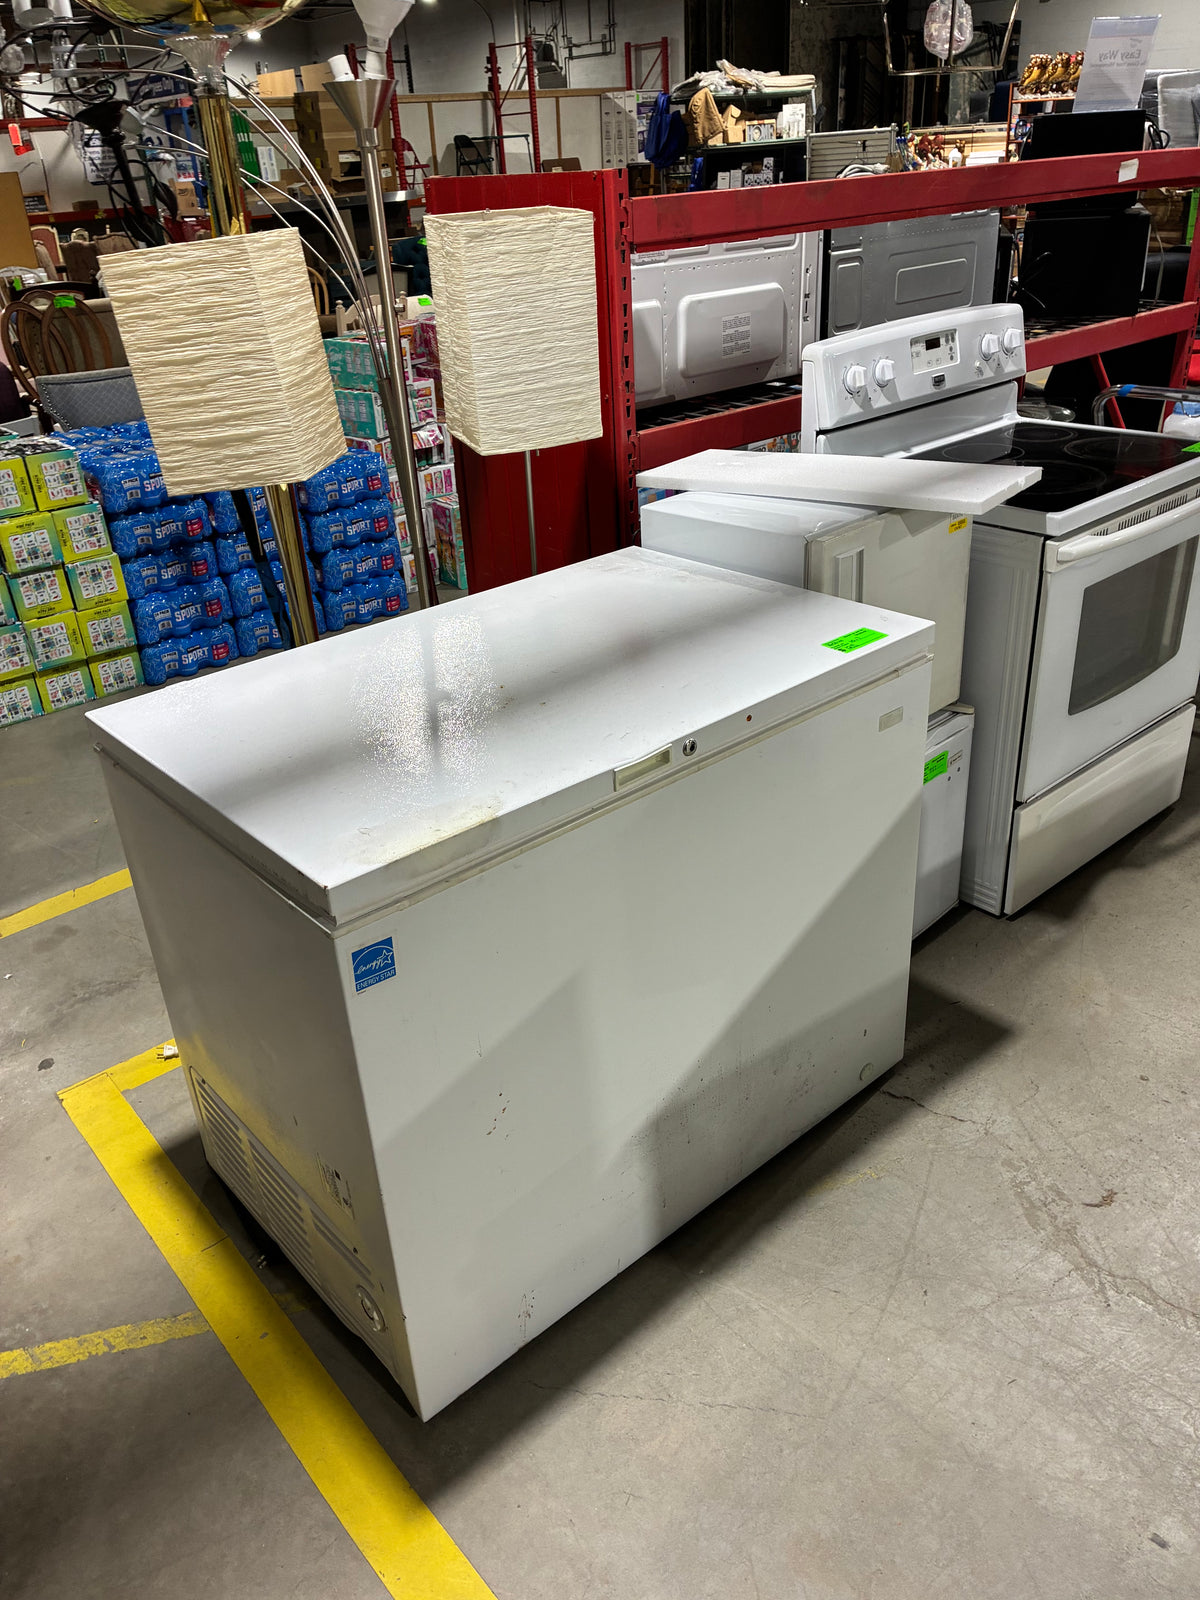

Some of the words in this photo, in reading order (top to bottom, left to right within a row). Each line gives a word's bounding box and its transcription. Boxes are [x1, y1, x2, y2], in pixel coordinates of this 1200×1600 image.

[341, 479, 364, 493] SPORT
[155, 522, 183, 539] SPORT
[347, 520, 370, 535] SPORT
[161, 563, 187, 579] SPORT
[357, 557, 378, 573] SPORT
[175, 604, 202, 622] SPORT
[359, 599, 383, 614] SPORT
[182, 647, 209, 665] SPORT
[357, 976, 380, 990] ENERGY
[380, 969, 395, 981] STAR
